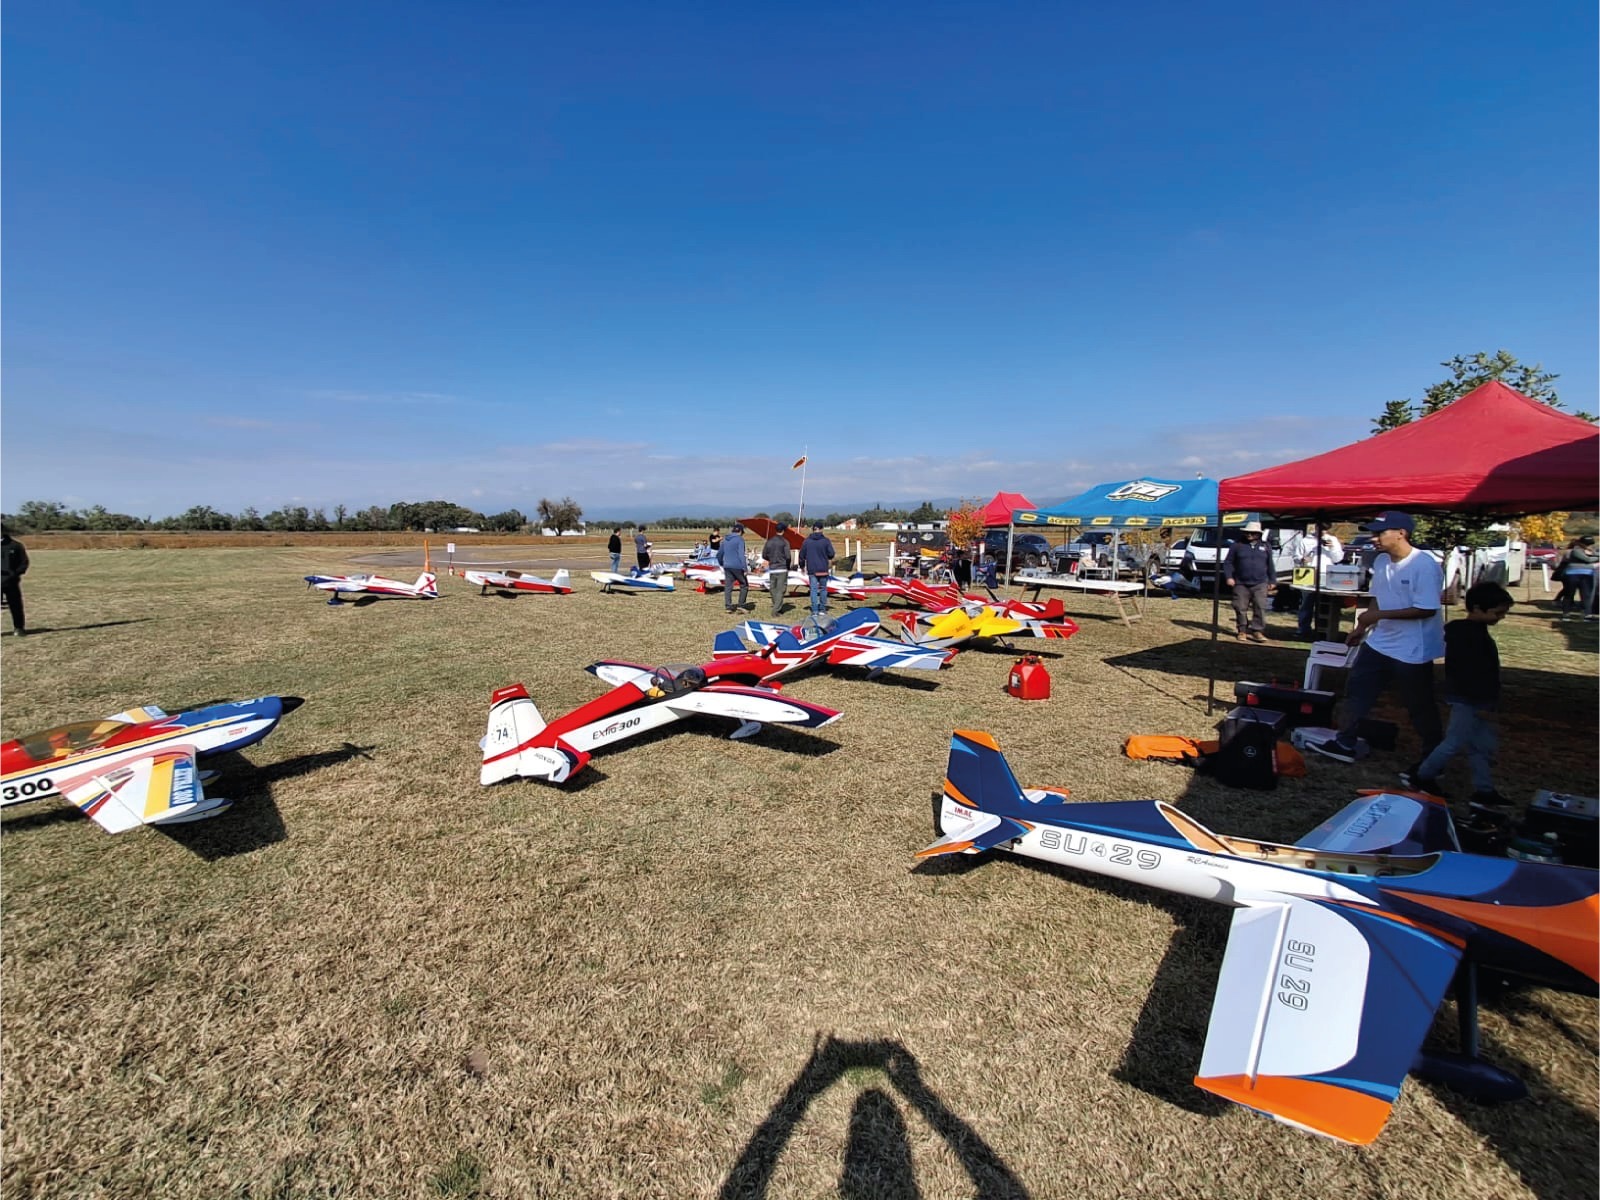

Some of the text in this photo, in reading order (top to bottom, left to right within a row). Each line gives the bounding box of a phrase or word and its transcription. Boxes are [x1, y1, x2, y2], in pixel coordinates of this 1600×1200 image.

[496, 727, 509, 741] 74
[618, 717, 641, 732] 300
[2, 778, 54, 800] 300
[1039, 829, 1162, 870] SU 29
[1277, 939, 1316, 1012] SU 29
